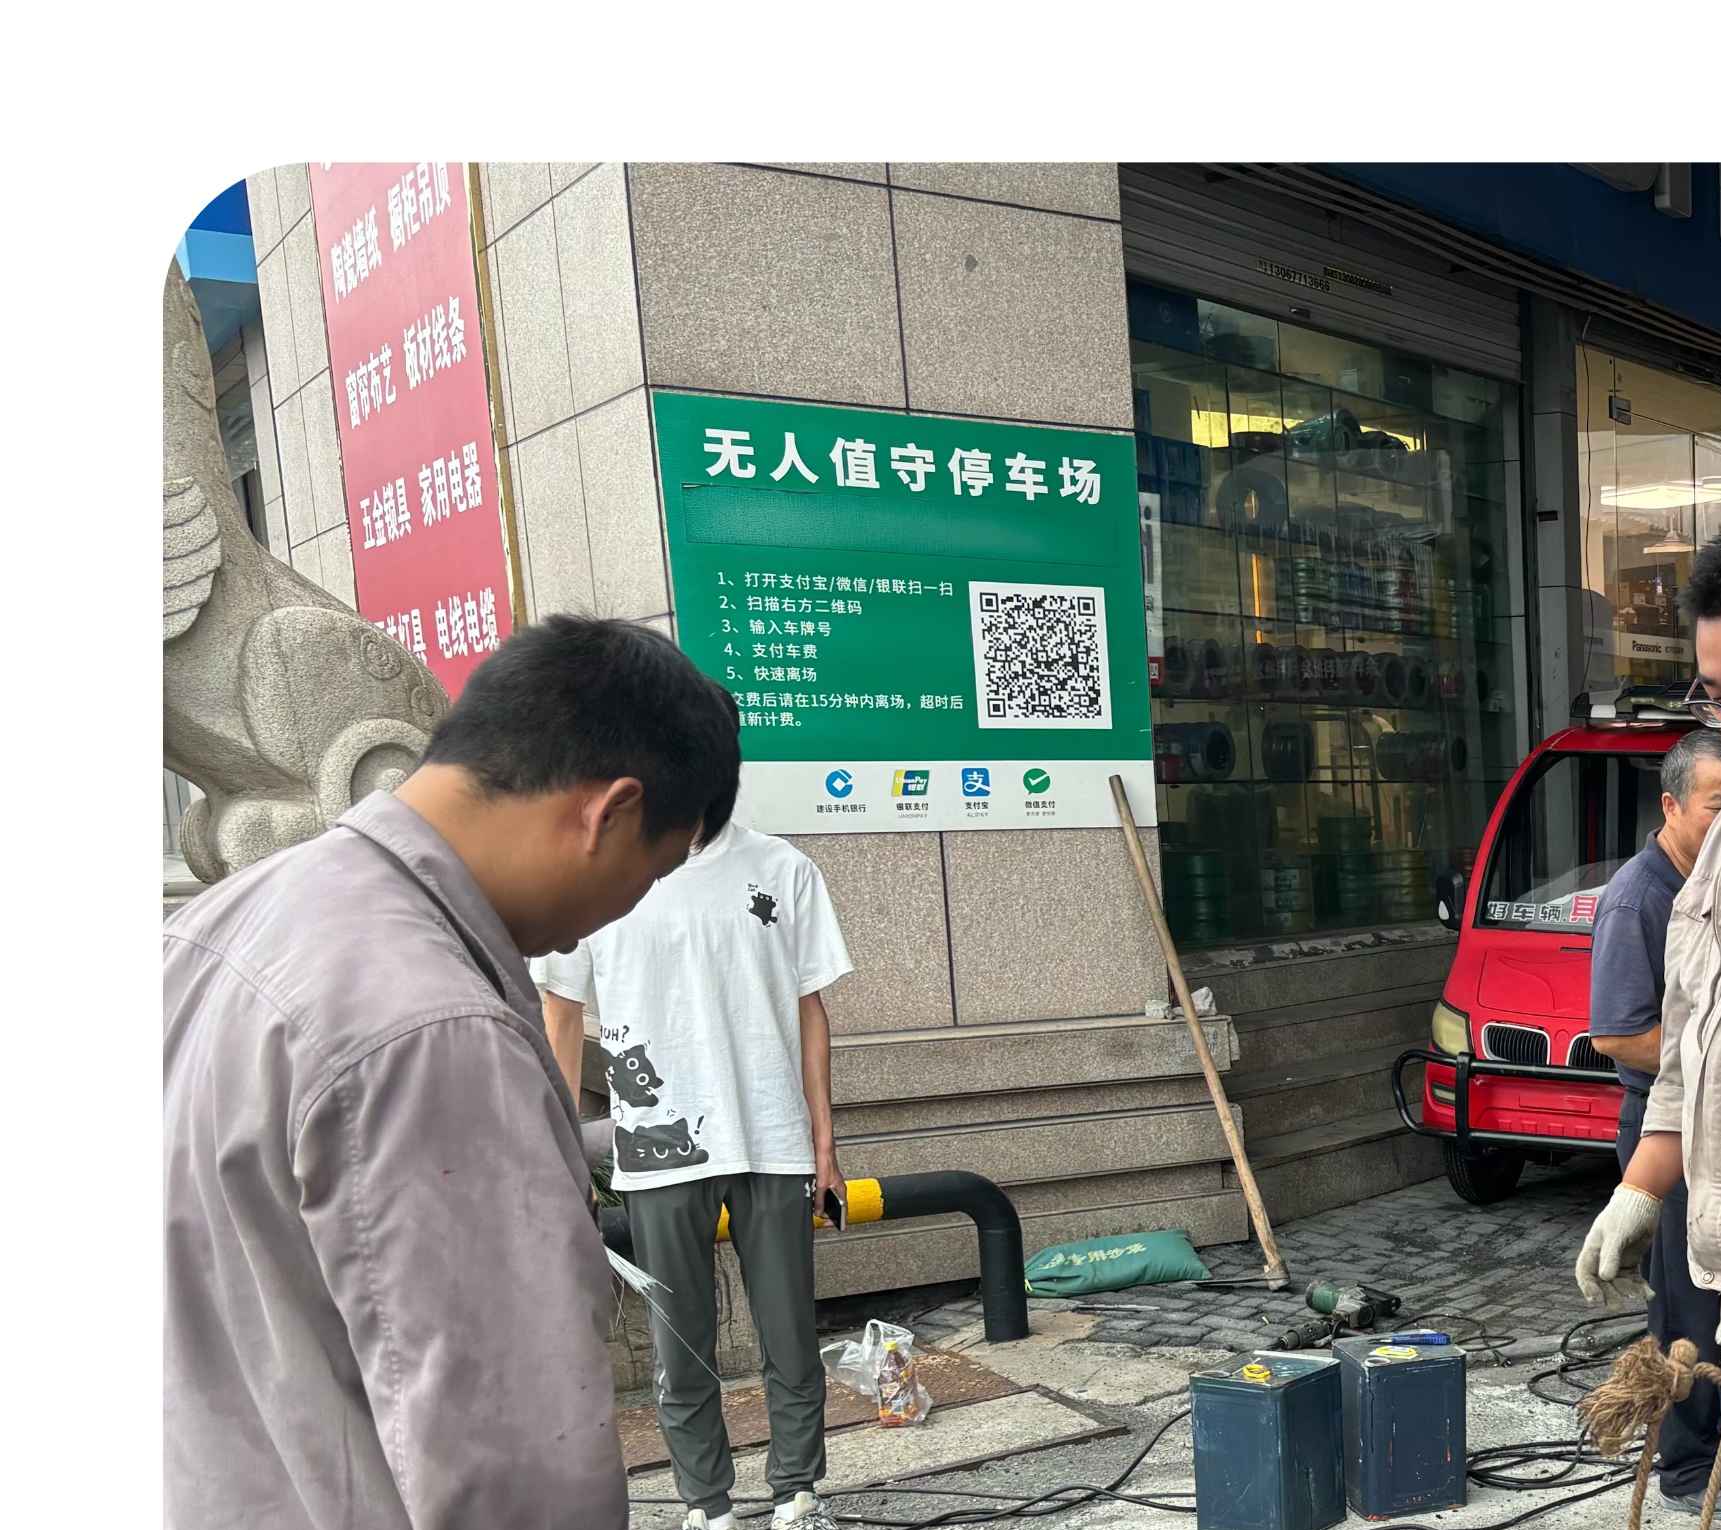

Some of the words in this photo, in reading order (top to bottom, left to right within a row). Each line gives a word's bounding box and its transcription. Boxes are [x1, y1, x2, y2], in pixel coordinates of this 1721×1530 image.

[330, 204, 383, 305] 陶瓷墙纸
[345, 342, 397, 430] 窗帘布艺
[403, 295, 468, 391] 板材线条
[702, 427, 1101, 505] 无人值守停车场
[360, 476, 412, 550] 五金锁具
[418, 441, 483, 527] 家用电器
[434, 586, 501, 660] 电线电缆
[1632, 639, 1662, 654] Panasonic
[816, 804, 867, 814] 建设手机银行
[896, 802, 929, 812] 银联支付
[965, 801, 989, 810] 支付宝
[1025, 800, 1056, 809] 微信支付
